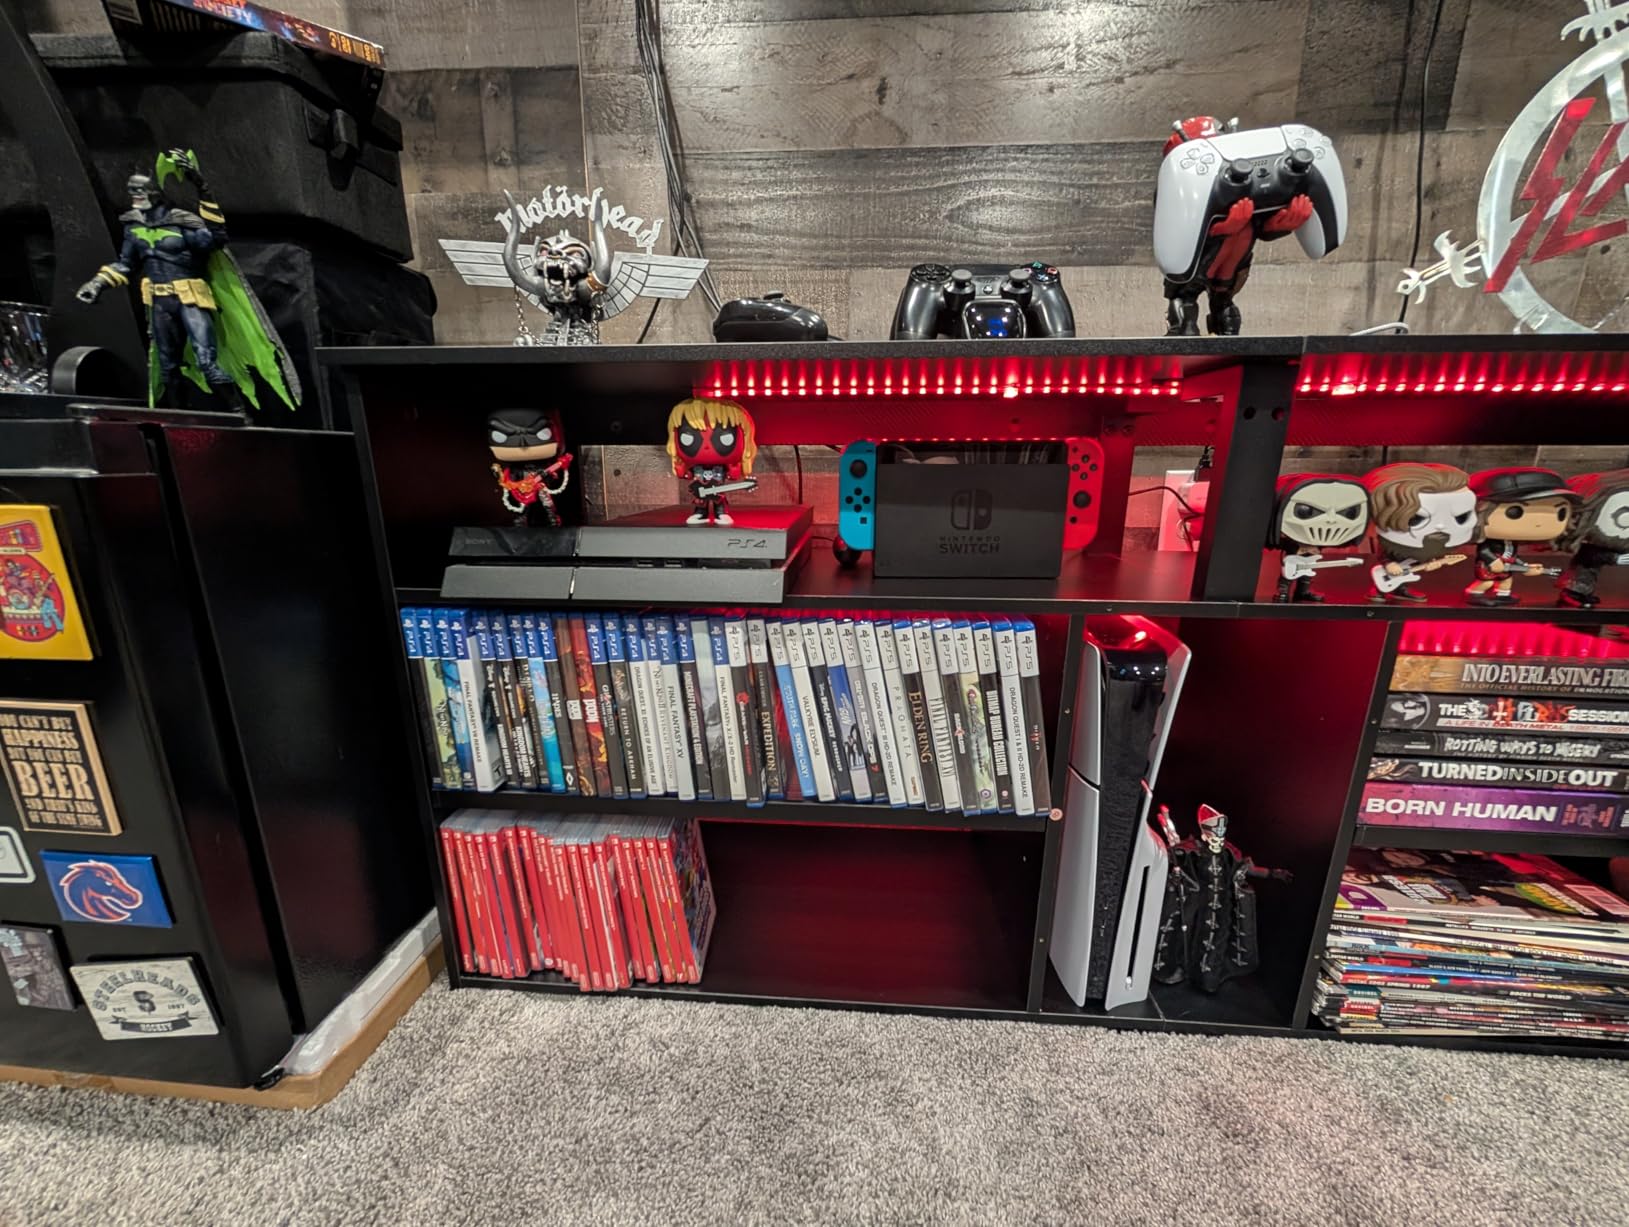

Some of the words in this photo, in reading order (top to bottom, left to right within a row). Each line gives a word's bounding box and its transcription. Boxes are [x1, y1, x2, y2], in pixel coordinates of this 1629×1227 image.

[727, 538, 768, 549] PS4
[939, 543, 1001, 554] SWITCH
[406, 631, 418, 653] PS4
[423, 631, 434, 654] PS4
[440, 632, 450, 654] PS4
[454, 633, 465, 656] PS4
[479, 633, 489, 655] PS4
[496, 634, 506, 656] PS4
[513, 631, 523, 653] PS4
[527, 632, 537, 654] PS4
[541, 632, 551, 655] PS4
[591, 635, 601, 659] PS4
[609, 633, 619, 656] PS4
[629, 635, 639, 658] PS4
[649, 634, 658, 657] PS4
[660, 638, 670, 660] PS4
[680, 634, 689, 657] PS4
[714, 638, 724, 660] PS4
[720, 676, 728, 693] FINAL
[1462, 663, 1500, 682] INTO
[1500, 665, 1602, 687] EVERLASTING
[464, 681, 473, 699] FINAL
[668, 686, 677, 708] FINAL
[1009, 687, 1019, 714] DRAGON
[583, 698, 600, 723] DOOM
[822, 696, 831, 712] EPIC
[930, 697, 947, 722] FINAL
[986, 690, 998, 714] BITMAP
[1438, 703, 1467, 717] THE
[671, 710, 682, 743] FANTASY
[802, 695, 815, 727] VALKYRIE
[810, 729, 821, 758] ELYSIUM
[825, 713, 836, 738] MICKEY
[871, 682, 882, 709] DRAGON
[887, 761, 897, 785] REMAKE
[908, 691, 926, 731] ELDEN
[917, 731, 933, 763] RING
[990, 716, 1003, 740] BUREAU
[1012, 716, 1021, 737] QUEST
[1, 728, 79, 749] HAPPINESS
[620, 708, 630, 735] RETURN
[627, 751, 636, 780] ARKHAM
[762, 711, 776, 771] EXPEDITION
[937, 725, 955, 764] FANTASY
[1444, 737, 1498, 753] ROTTING
[1500, 741, 1537, 755] WAYS
[1539, 744, 1553, 754] TO
[1555, 743, 1601, 759] MISERY
[500, 749, 511, 769] HEARTS
[515, 726, 526, 753] KINGDOM
[521, 754, 531, 777] HEARTS
[676, 748, 684, 758] XV
[994, 741, 1008, 775] COLLECTION
[11, 761, 95, 800] BEER
[1019, 772, 1028, 798] REMAKE
[1418, 762, 1503, 781] TURNED
[1502, 766, 1568, 785] INSIDE
[1567, 769, 1618, 788] OUT
[1365, 798, 1445, 816] BORN
[1452, 801, 1557, 822] HUMAN
[92, 970, 200, 1011] STEELHEADS
